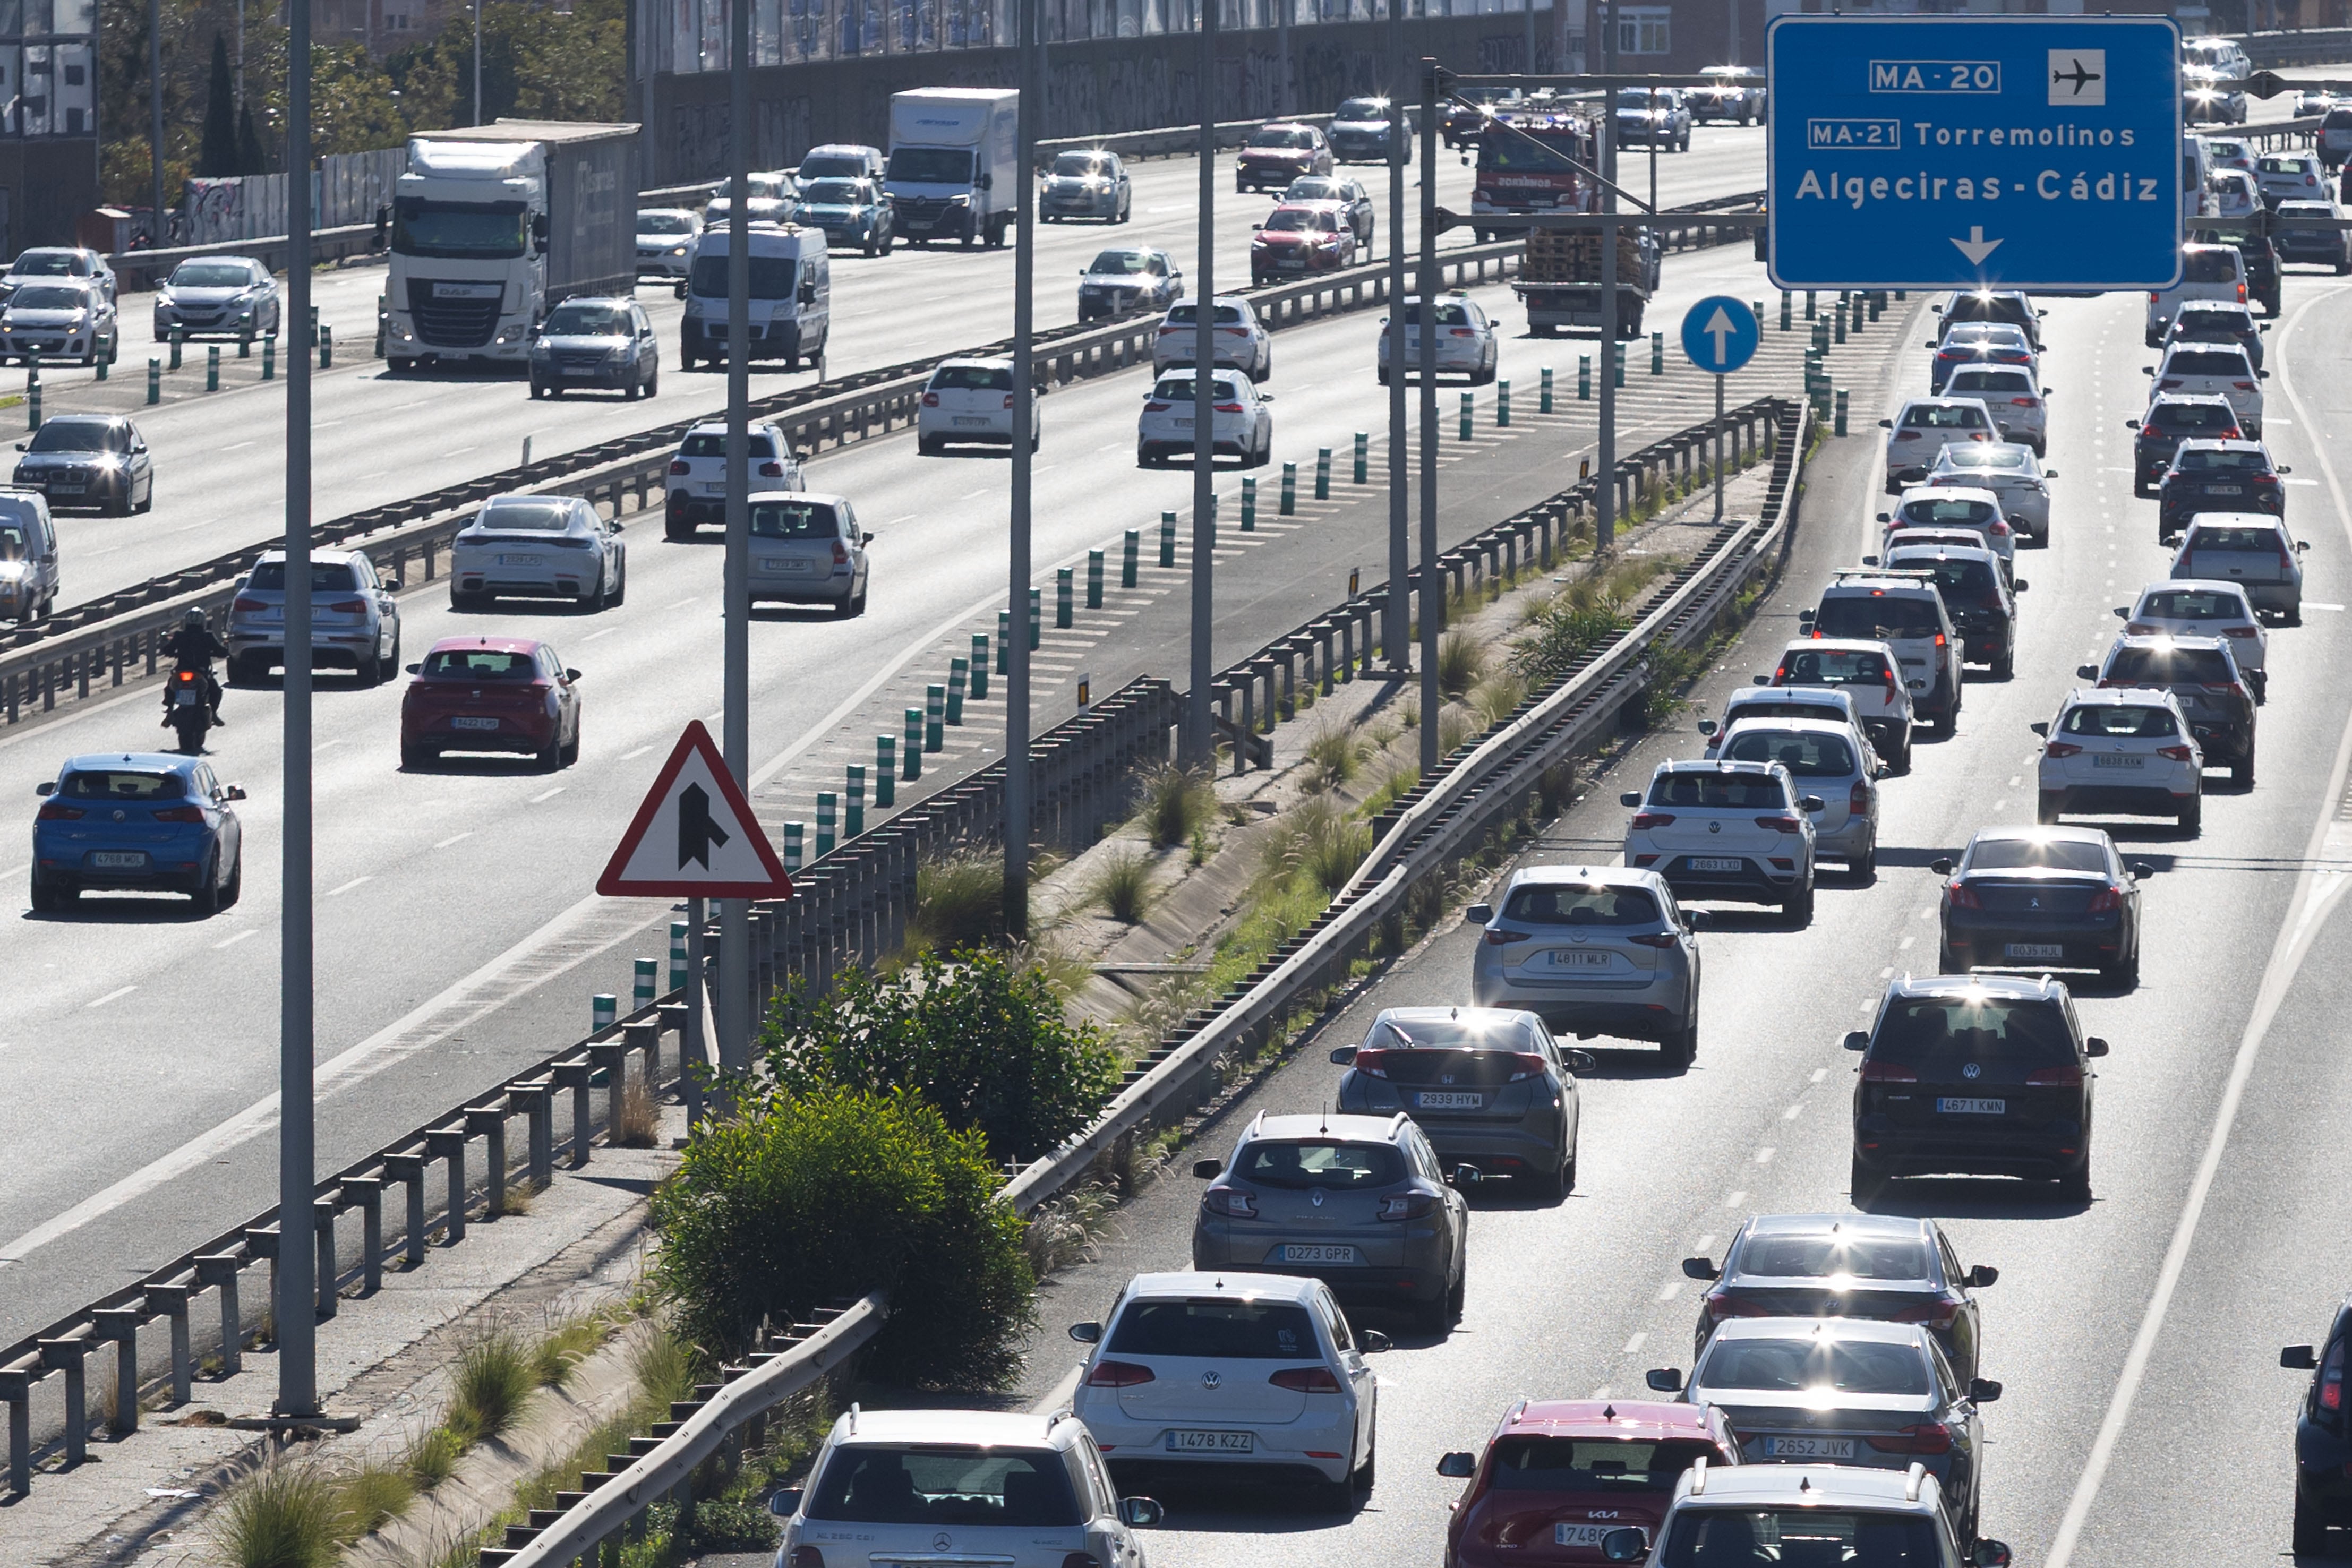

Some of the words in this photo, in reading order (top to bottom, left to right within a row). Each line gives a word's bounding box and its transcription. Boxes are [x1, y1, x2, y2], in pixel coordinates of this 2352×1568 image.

[1877, 65, 1994, 88] MA-20
[1814, 125, 1895, 143] MA-21
[1914, 123, 2134, 145] Torremolinos
[1694, 860, 1718, 869] 2663
[1721, 860, 1740, 870] LXD
[2013, 946, 2038, 955] 6035
[2041, 946, 2059, 956] HJL
[1556, 955, 1583, 964] 4811
[1587, 955, 1608, 965] MLR
[1422, 1093, 1452, 1104] 2939
[1456, 1094, 1479, 1105] HYM
[1945, 1100, 1974, 1111] 4671
[1978, 1101, 2002, 1112] KMN
[1288, 1247, 1321, 1260] 0273
[1325, 1248, 1351, 1261] GPR
[1180, 1433, 1216, 1447] 1478
[1221, 1434, 1249, 1449] KZZ
[1777, 1440, 1816, 1454] 2652
[1821, 1442, 1850, 1457] JVK
